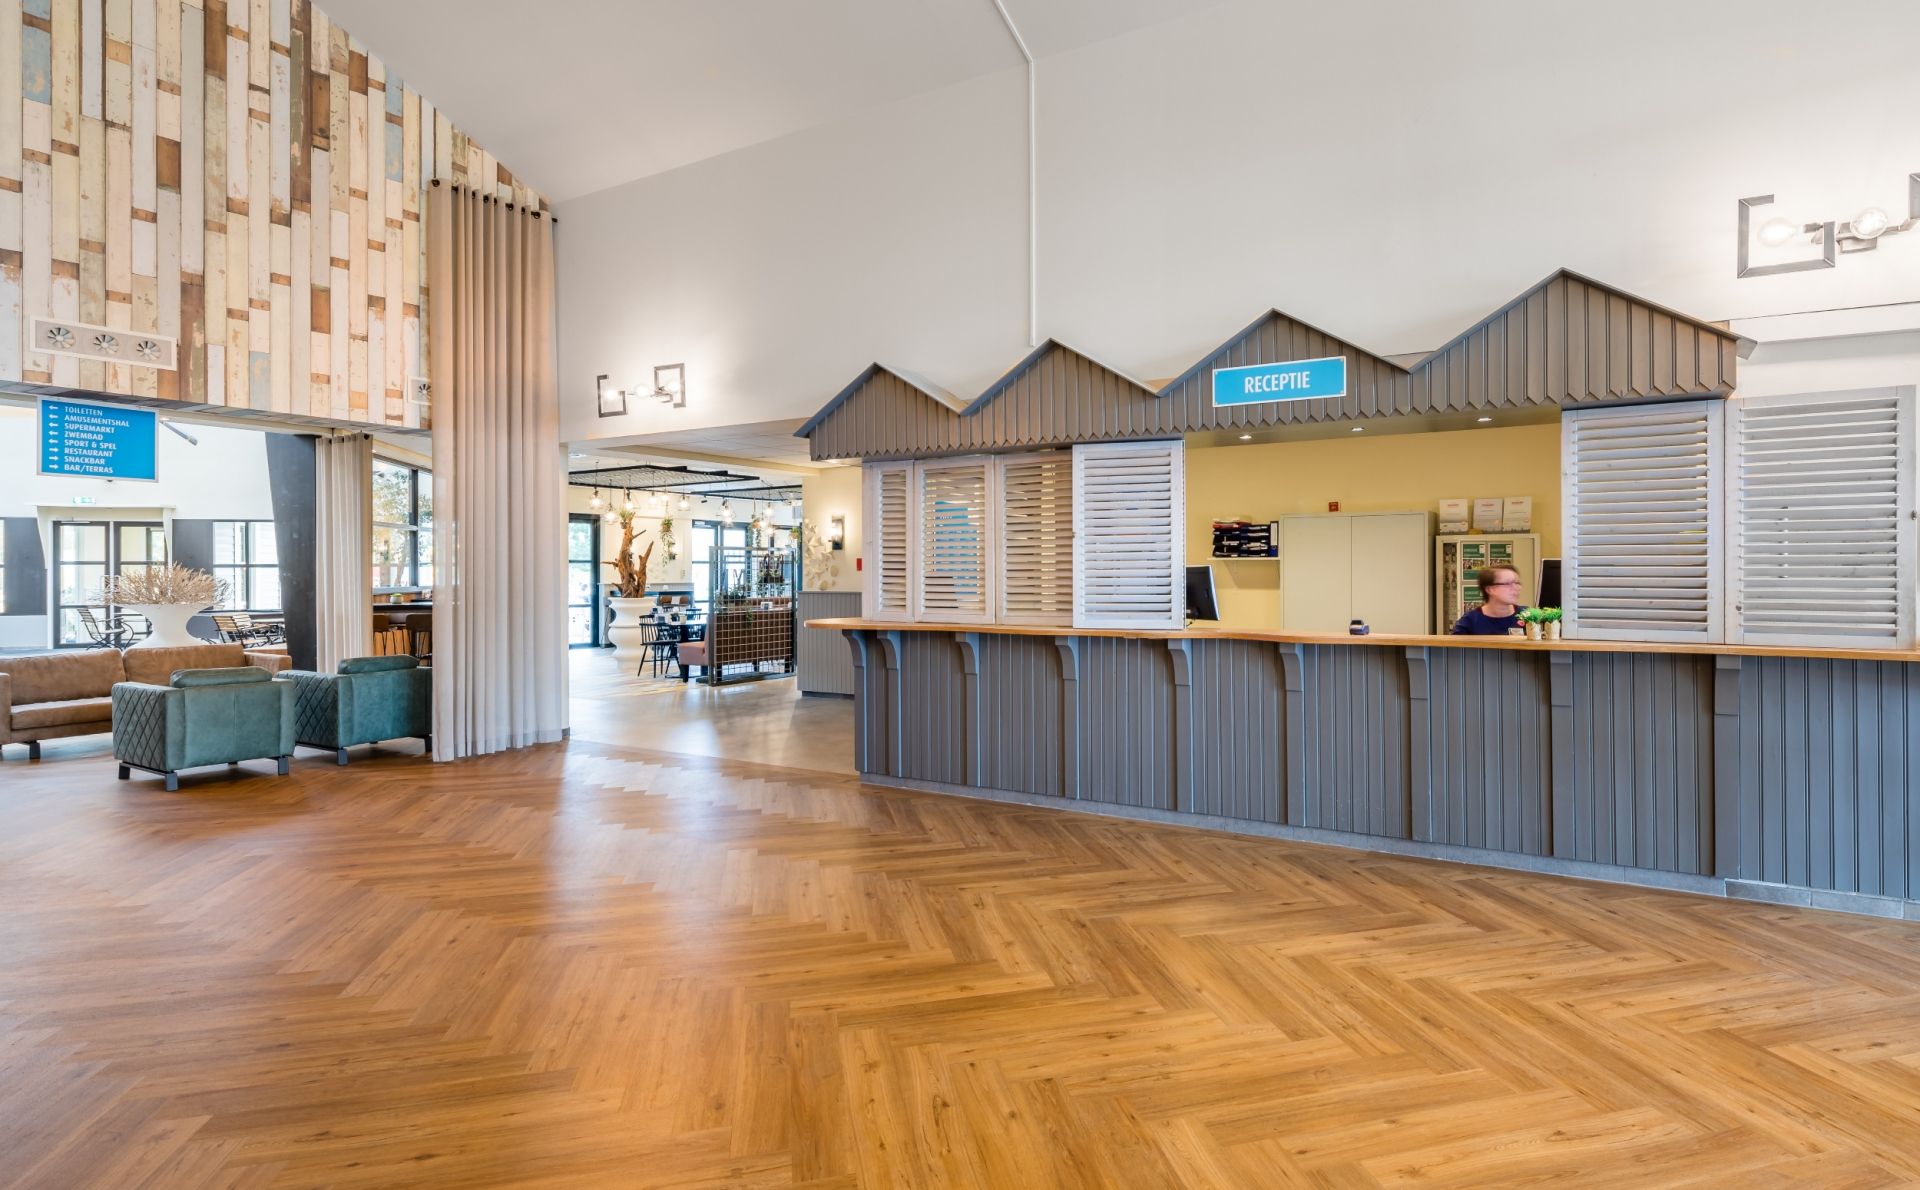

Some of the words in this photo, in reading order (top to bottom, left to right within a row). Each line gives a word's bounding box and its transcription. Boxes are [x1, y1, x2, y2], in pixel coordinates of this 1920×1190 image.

[1244, 371, 1311, 394] RECEPTIE
[64, 406, 103, 416] TOILETTEN
[64, 415, 130, 427] AMUSEMENTSHAL
[64, 423, 115, 433] SUPERMARKT
[64, 431, 103, 440] ZWEMBAD
[64, 439, 89, 447] SPORT
[99, 442, 117, 450] SPEL
[64, 447, 113, 457] RESTAURANT
[64, 455, 105, 465] SNACKBAR
[64, 464, 114, 473] BAR/TERRAS
